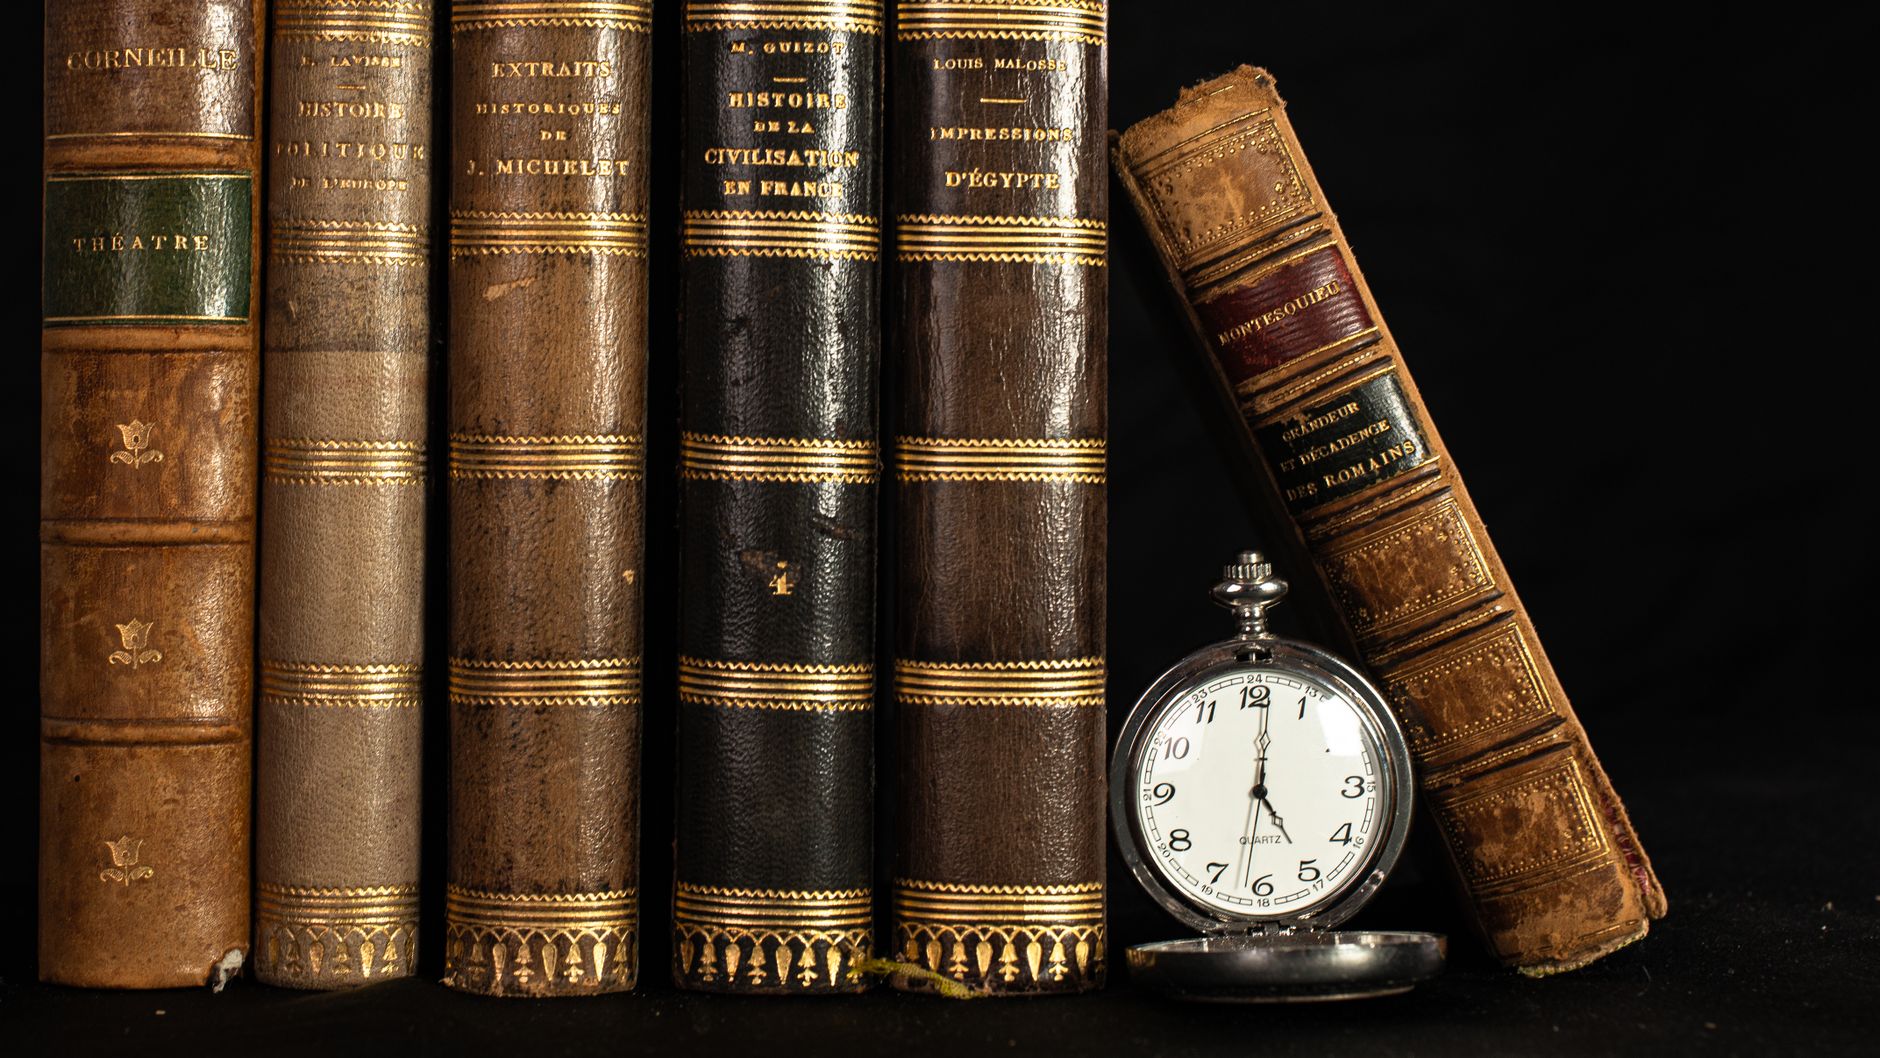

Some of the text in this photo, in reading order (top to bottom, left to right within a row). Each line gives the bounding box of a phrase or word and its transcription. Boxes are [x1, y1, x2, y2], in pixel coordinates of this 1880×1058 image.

[730, 41, 846, 55] M. GUIZOT
[67, 47, 239, 71] CORNEILLE
[934, 58, 1068, 72] LOUIS MALOSSE
[491, 61, 612, 78] EXTRAITS
[299, 101, 406, 119] HISTOIRE
[476, 102, 621, 116] HISTORIQUES
[728, 91, 847, 110] HISTOIRE
[540, 128, 567, 142] DE
[753, 120, 815, 134] DE LA
[930, 127, 1074, 142] IMPRESSIONS
[467, 157, 630, 177] J. MICHELET
[704, 148, 859, 168] CIVILISATION
[945, 167, 1061, 189] D'ÉGYPTE
[724, 180, 843, 197] EN FRANCE
[73, 234, 209, 253] THÉATRE
[1217, 280, 1341, 346] MONTESQUIEU
[1282, 401, 1361, 443] GRANDEUR
[1280, 459, 1297, 473] ET
[1286, 439, 1416, 502] DES ROMAINS
[1246, 673, 1264, 684] 24
[1192, 689, 1208, 704] 23
[1239, 685, 1272, 711] 12
[1304, 685, 1319, 698] 13
[1195, 699, 1218, 725] 11
[1296, 695, 1308, 721] 1
[1163, 736, 1191, 761] 10
[1142, 788, 1153, 802] 21
[1152, 782, 1176, 807] 9
[1340, 775, 1366, 800] 3
[1168, 828, 1193, 853] 8
[1238, 834, 1283, 846] QUARTZ
[1328, 822, 1354, 847] 4
[1155, 843, 1172, 859] 20
[1205, 861, 1230, 885] 7
[1297, 858, 1322, 883] 5
[1200, 884, 1215, 897] 19
[1251, 873, 1274, 898] 6
[1310, 879, 1327, 893] 17
[1256, 896, 1271, 908] 18
